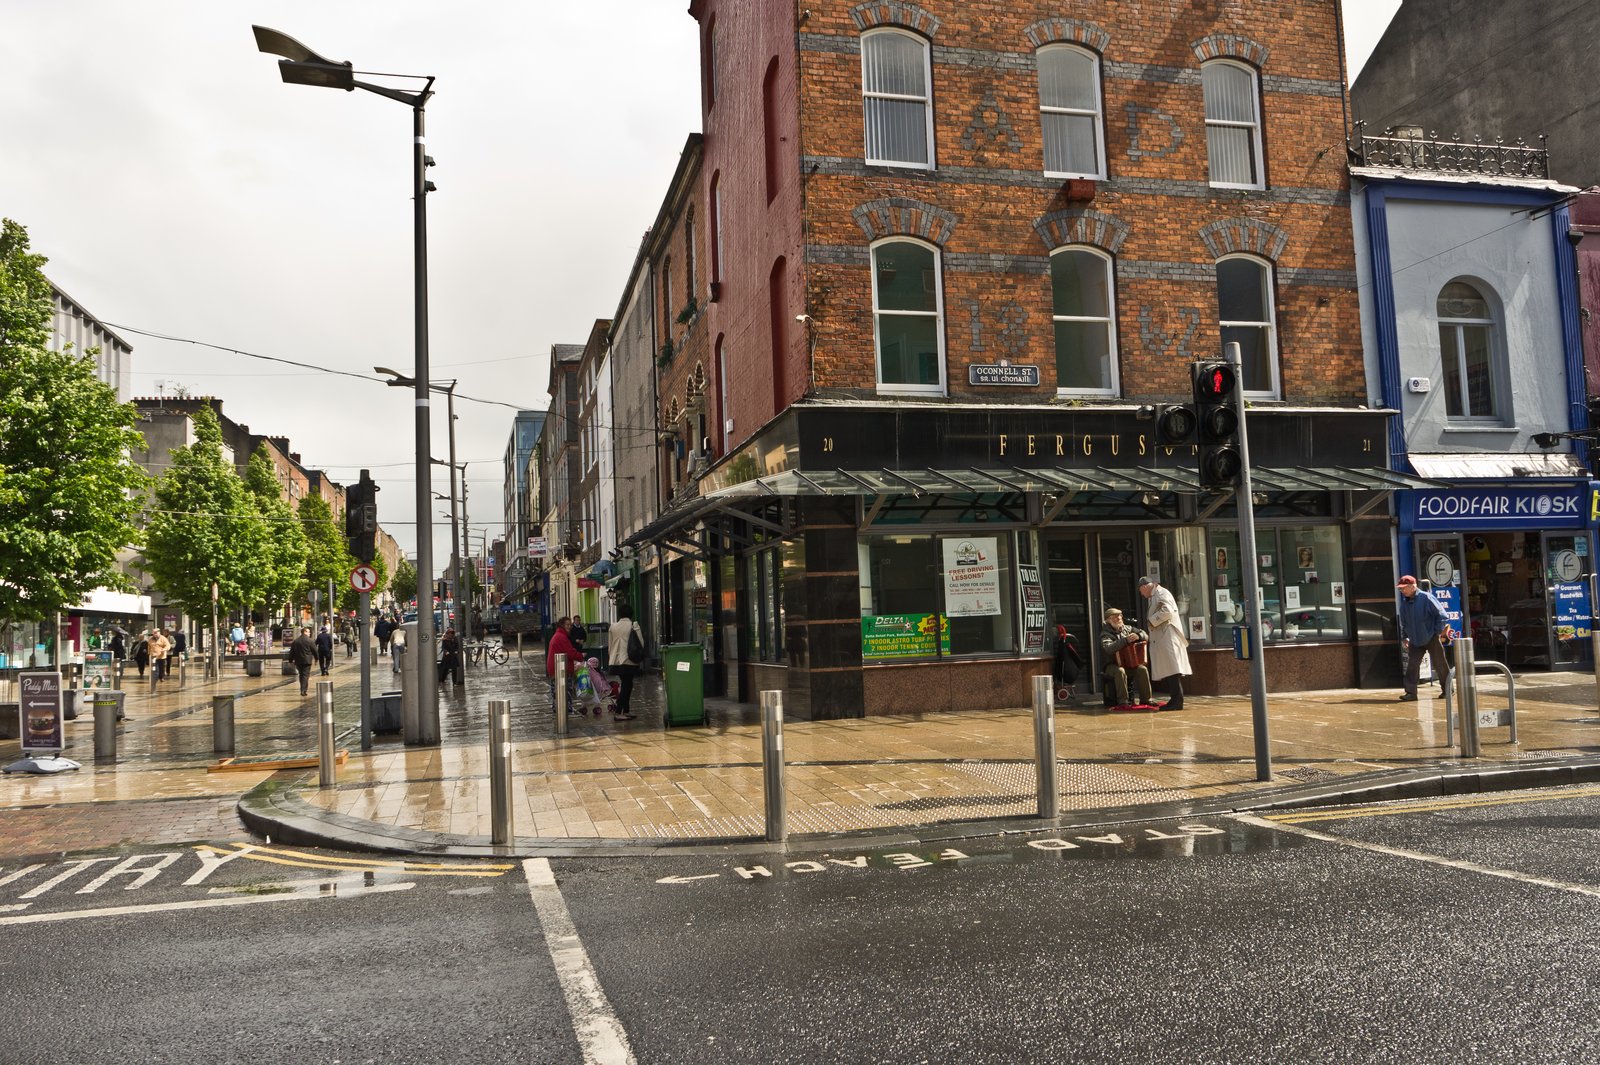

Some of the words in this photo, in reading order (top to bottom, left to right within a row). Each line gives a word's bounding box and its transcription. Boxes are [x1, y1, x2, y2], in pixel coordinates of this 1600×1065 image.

[823, 437, 834, 452] 20
[1363, 438, 1371, 452] 21
[1418, 495, 1510, 516] FOODFAIR
[1515, 494, 1579, 516] KIOSK
[967, 565, 994, 573] DRIVING
[1021, 568, 1029, 582] TO
[1028, 569, 1039, 583] LET
[951, 572, 985, 581] LESSONS?
[1435, 589, 1452, 599] TEA
[1559, 591, 1584, 599] Sandwich
[875, 616, 903, 624] DELTA
[1027, 613, 1035, 628] TO
[1035, 613, 1045, 628] LET
[22, 678, 41, 694] Paddy
[1027, 823, 1227, 851] STAD
